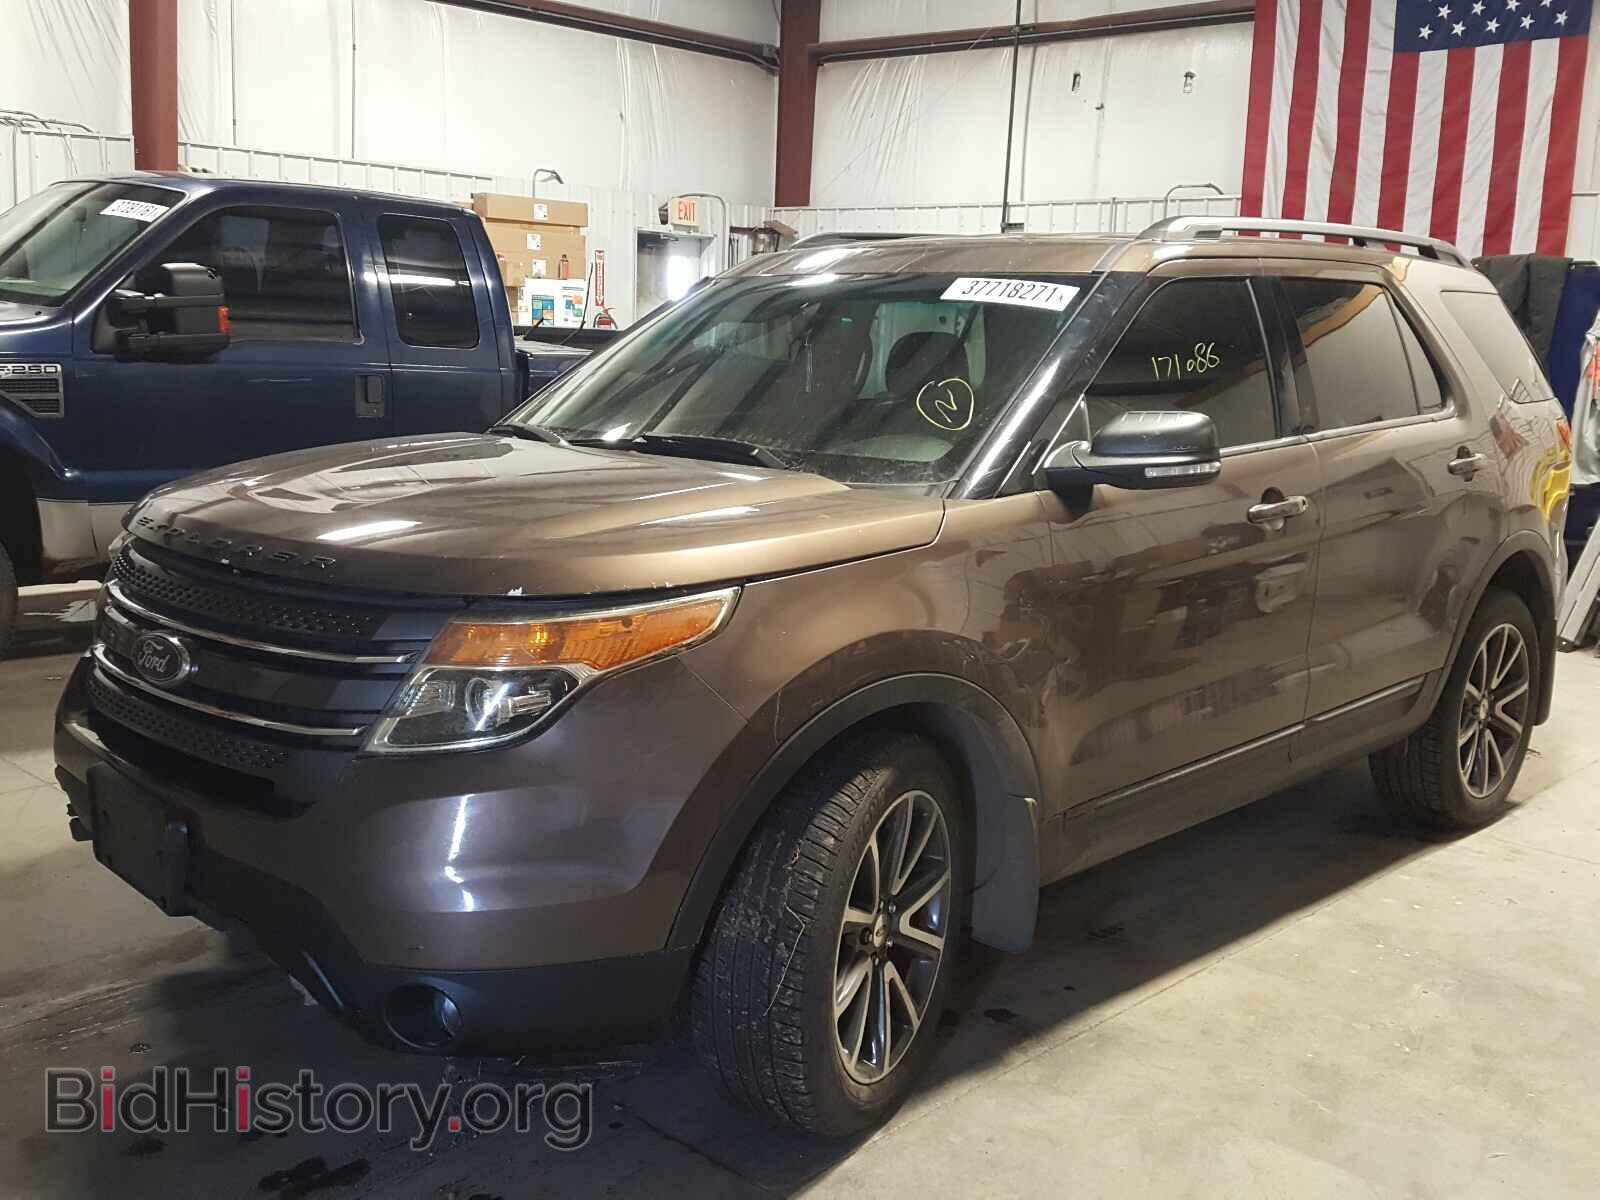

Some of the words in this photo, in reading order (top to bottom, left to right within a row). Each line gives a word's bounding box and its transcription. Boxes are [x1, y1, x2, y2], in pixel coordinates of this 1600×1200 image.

[678, 200, 697, 223] EXIT
[961, 280, 1058, 303] 37718271
[1151, 342, 1221, 381] 171086
[136, 515, 337, 569] EPRER
[137, 638, 169, 673] Ford
